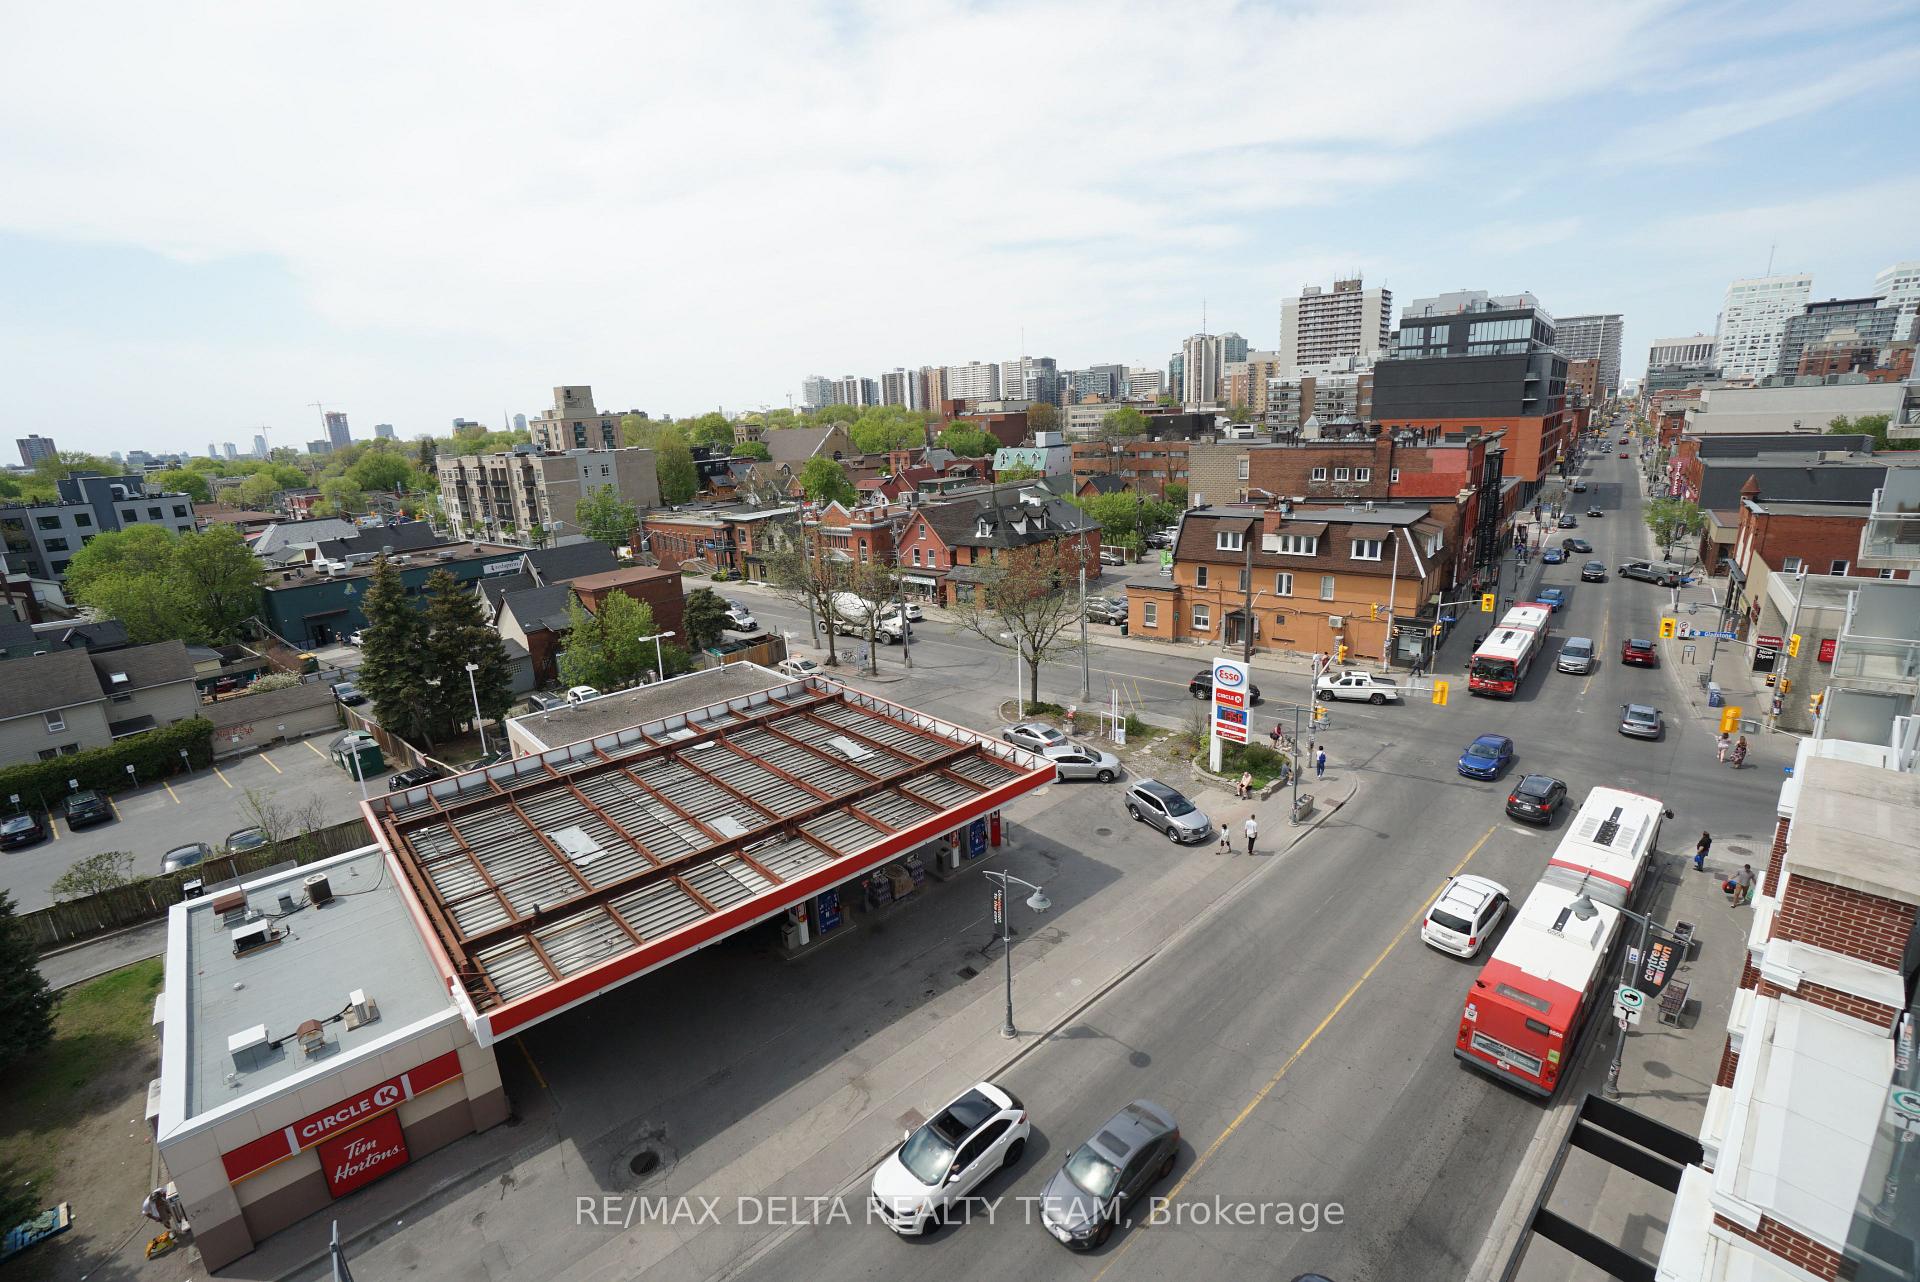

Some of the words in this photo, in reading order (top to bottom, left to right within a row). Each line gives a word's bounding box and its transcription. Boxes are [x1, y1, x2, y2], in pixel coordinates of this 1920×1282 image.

[1704, 631, 1733, 639] Gladstone
[1217, 692, 1235, 701] CIRCLE
[1643, 949, 1661, 982] centre
[1658, 945, 1673, 972] town
[302, 1099, 371, 1138] CIRCLE
[373, 1085, 399, 1107] K
[343, 1137, 377, 1160] Tim
[334, 1144, 400, 1184] Hortons
